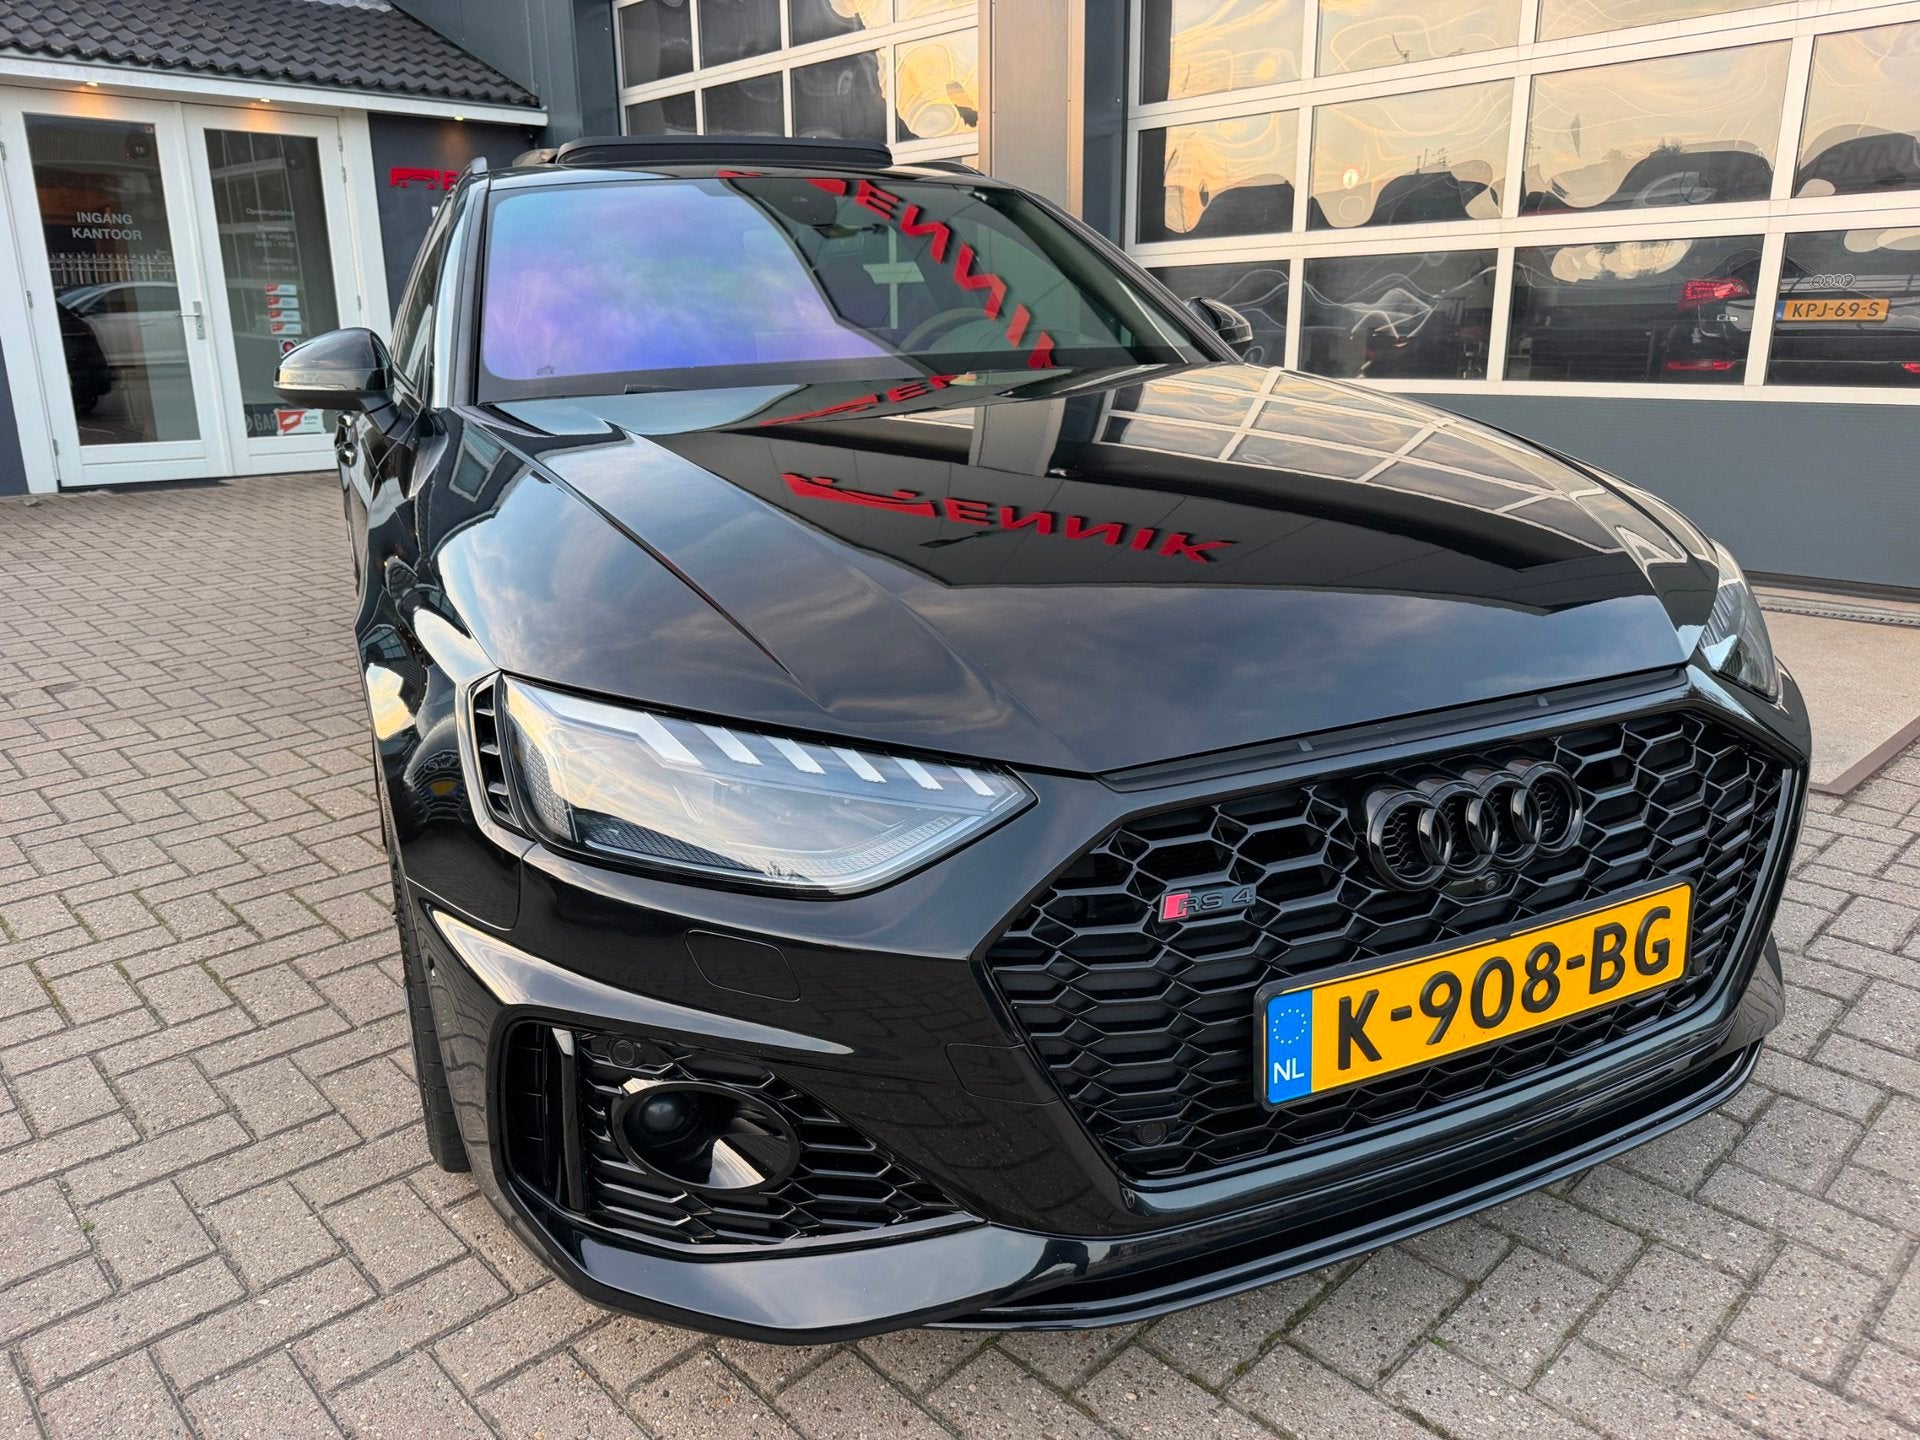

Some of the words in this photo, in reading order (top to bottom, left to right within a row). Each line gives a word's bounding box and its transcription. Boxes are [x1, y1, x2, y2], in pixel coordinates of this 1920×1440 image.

[76, 211, 133, 225] INGANG
[71, 227, 143, 240] KANTOOR
[1791, 301, 1881, 318] KPJ-69-S
[1337, 905, 1672, 1070] K-908-BG
[1273, 1057, 1306, 1085] NL
